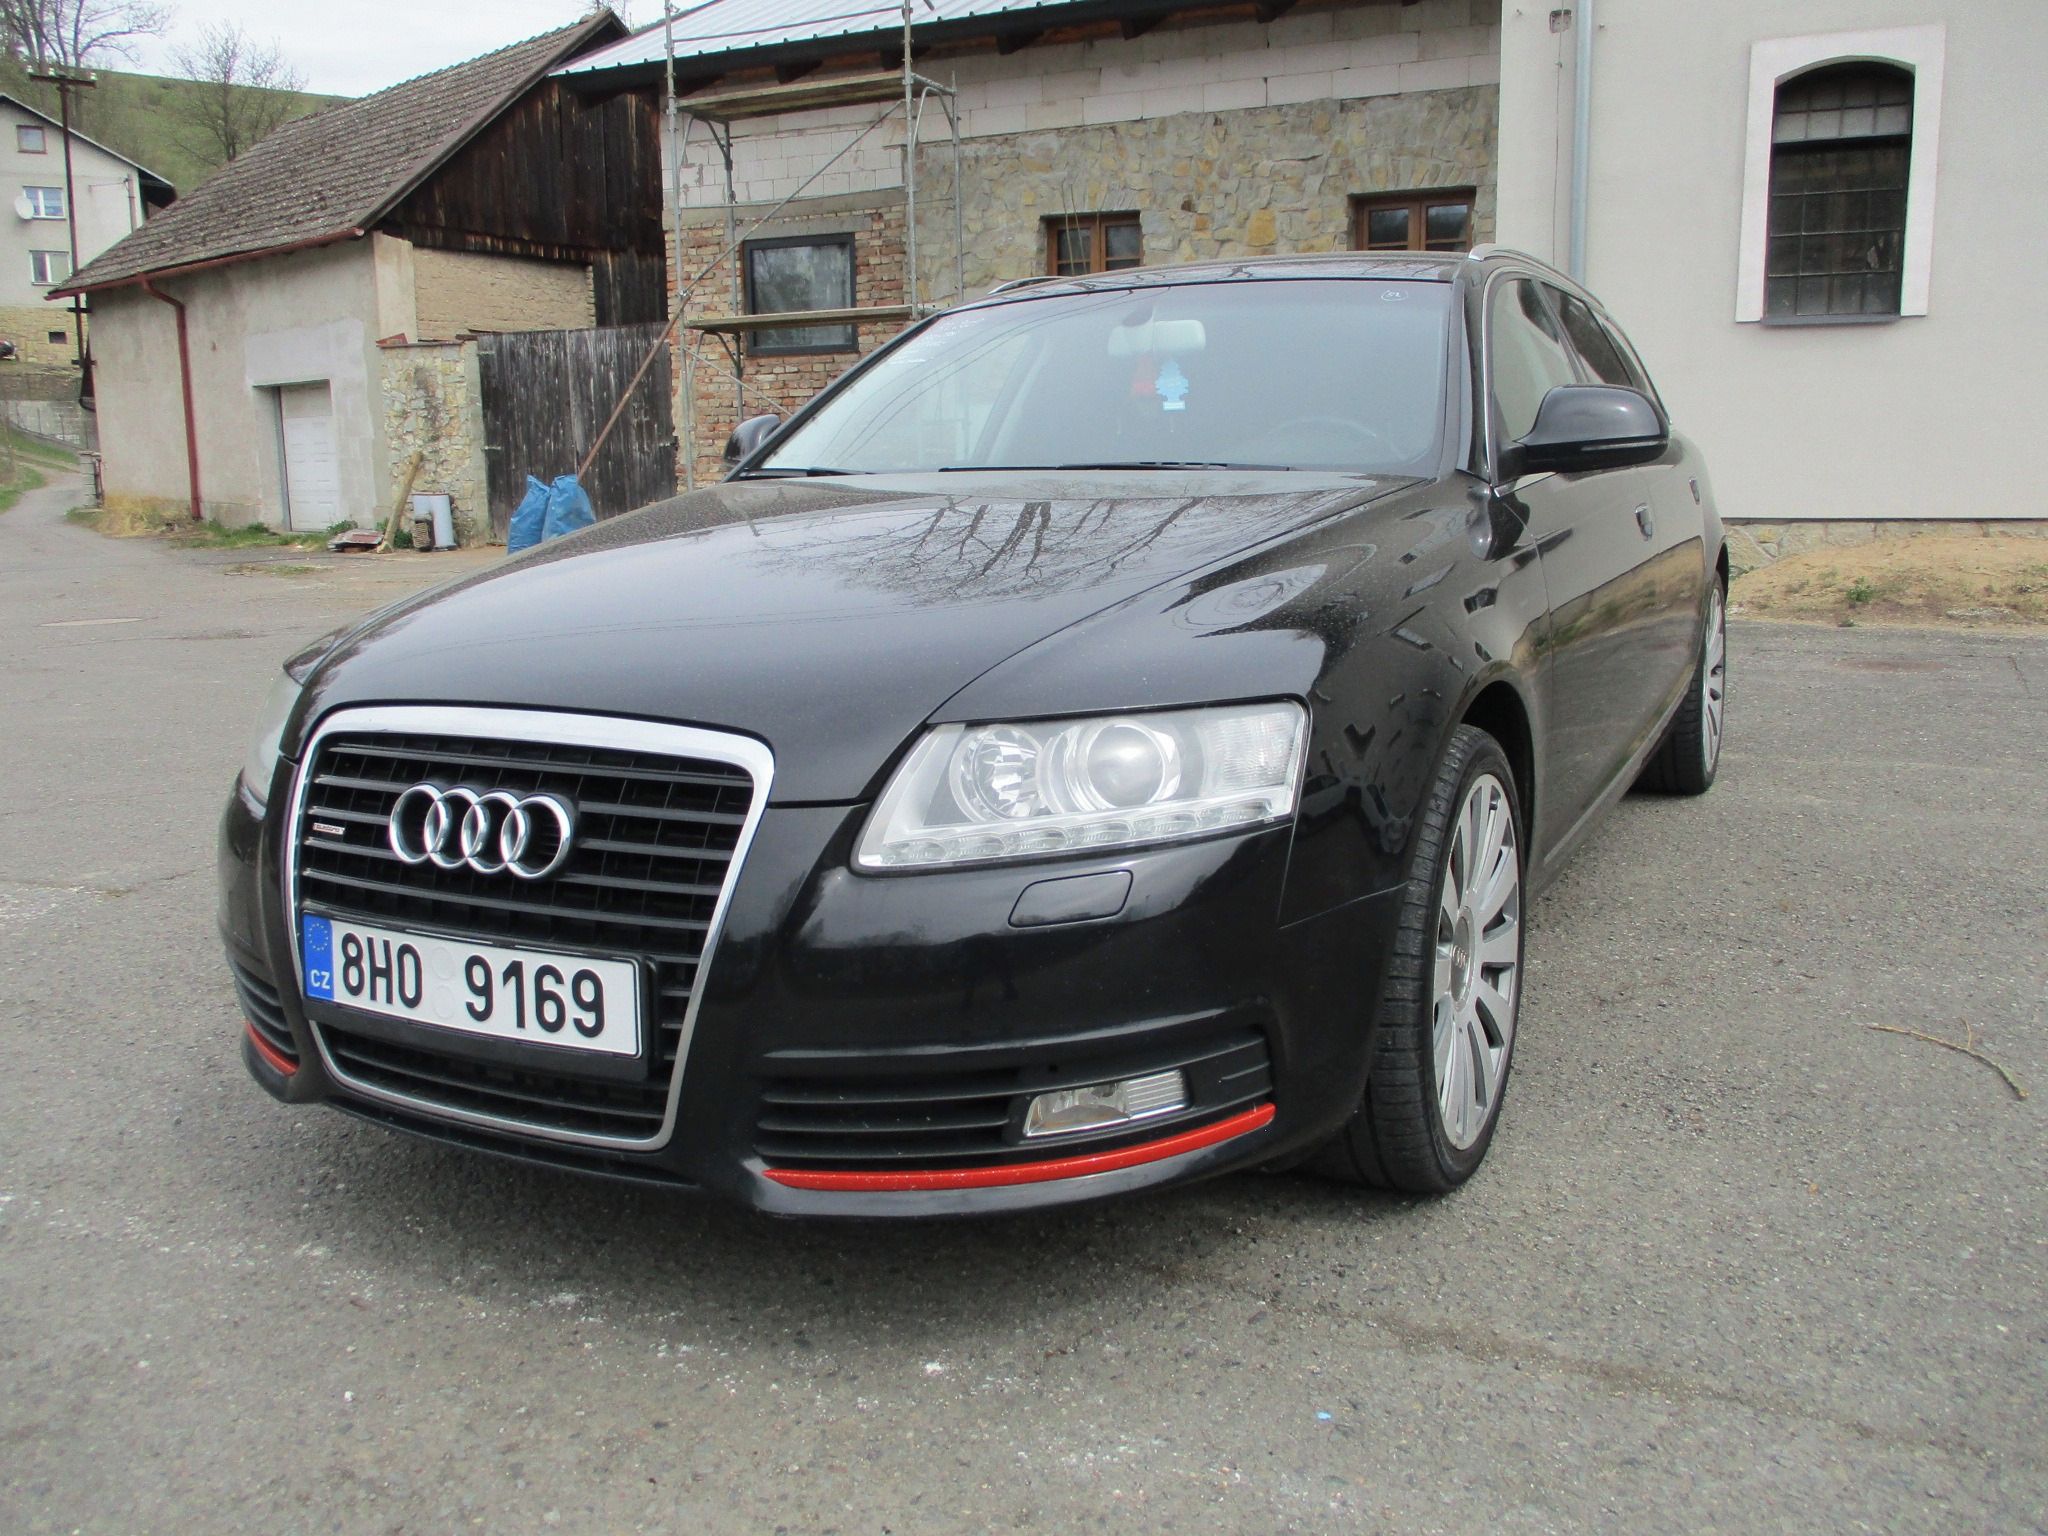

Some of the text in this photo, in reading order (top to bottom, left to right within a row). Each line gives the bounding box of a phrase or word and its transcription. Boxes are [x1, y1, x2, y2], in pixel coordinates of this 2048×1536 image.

[310, 968, 331, 990] CZ
[341, 932, 606, 1038] 8H0 9169
